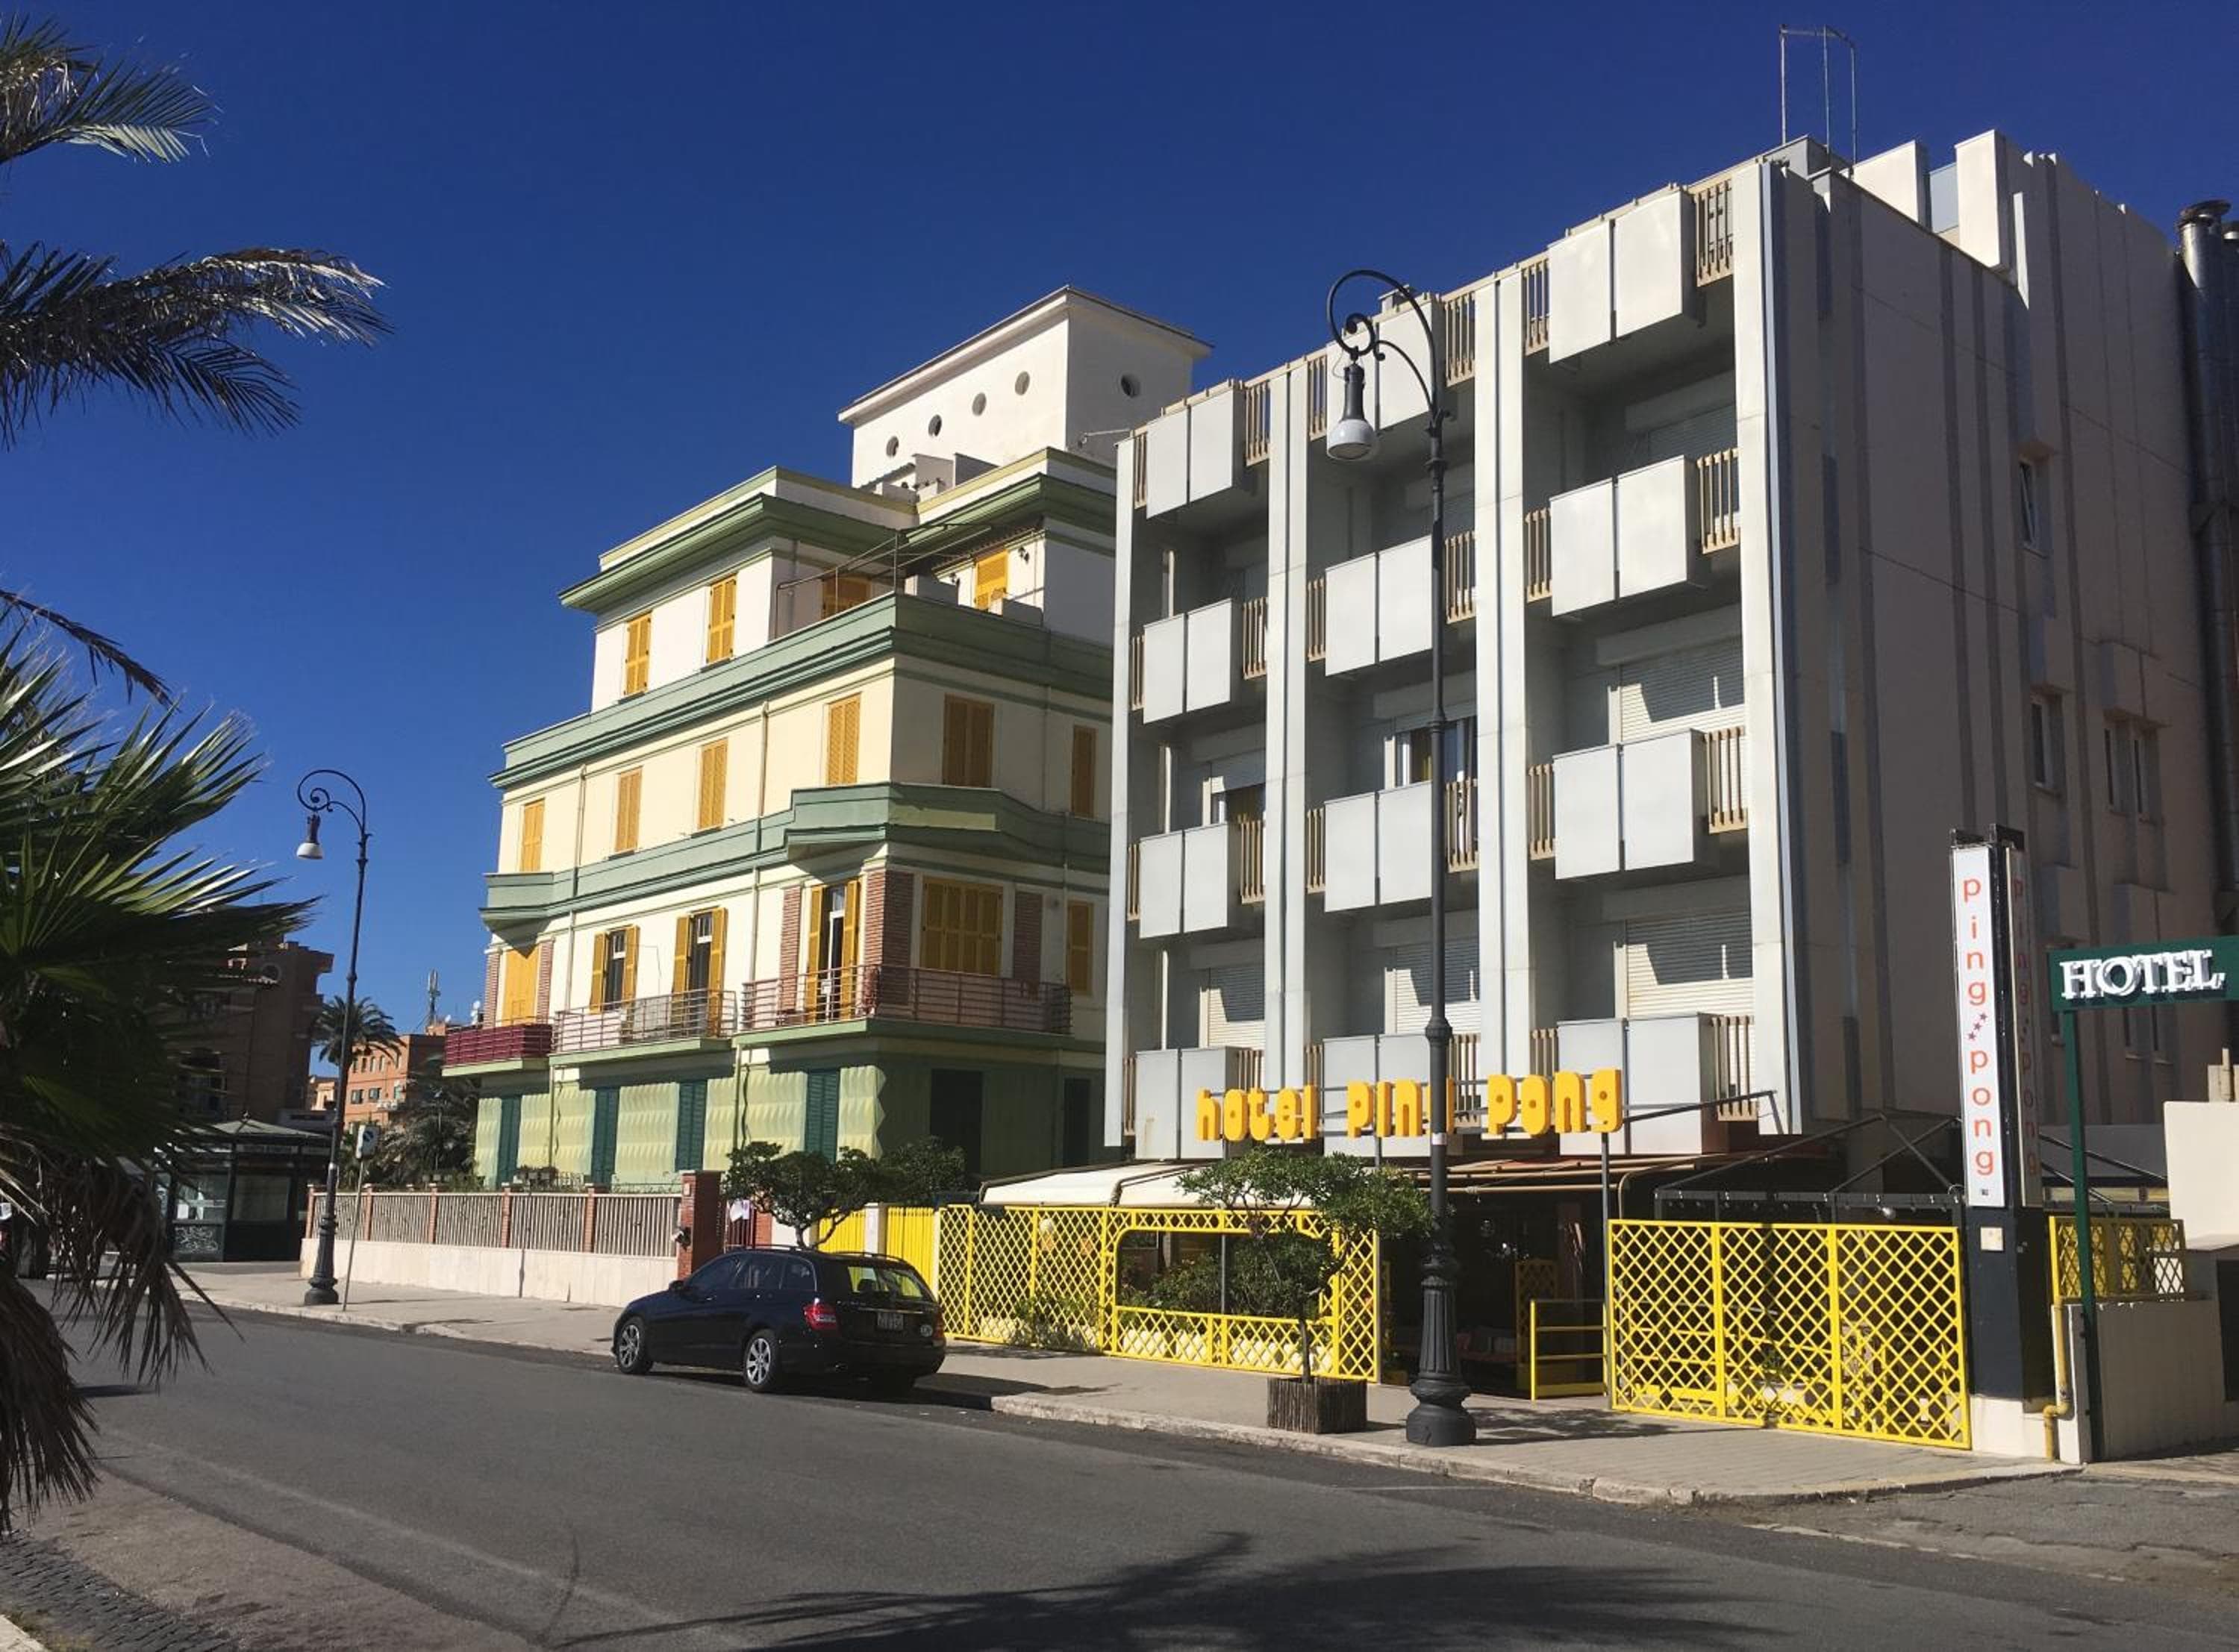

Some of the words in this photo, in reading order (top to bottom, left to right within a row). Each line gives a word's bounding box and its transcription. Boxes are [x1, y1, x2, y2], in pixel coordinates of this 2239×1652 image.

[1964, 877, 1987, 1007] ping
[2059, 949, 2225, 1000] HOTEL
[1196, 1084, 1318, 1141] hotel
[1487, 1068, 1623, 1136] pong
[1970, 1049, 1995, 1176] pong
